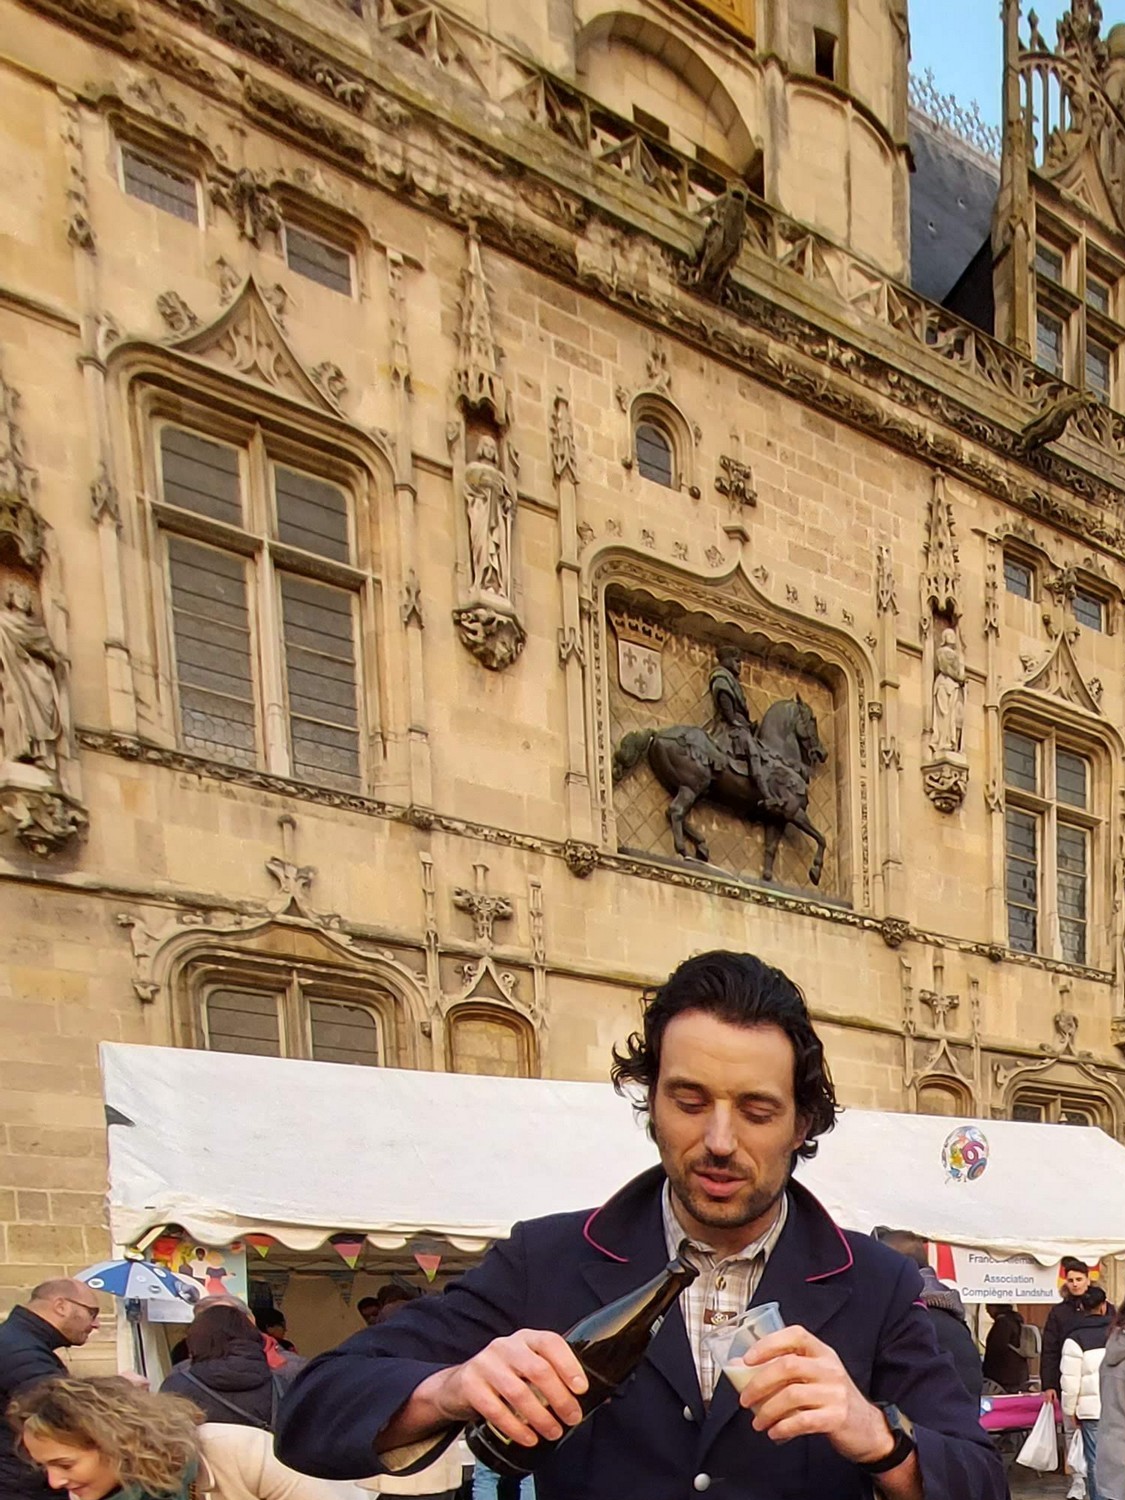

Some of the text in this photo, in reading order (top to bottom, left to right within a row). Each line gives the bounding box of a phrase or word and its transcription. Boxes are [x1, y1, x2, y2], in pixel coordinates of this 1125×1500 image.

[983, 1274, 1034, 1284] Association
[962, 1287, 1053, 1298] Compiègne Landshut
